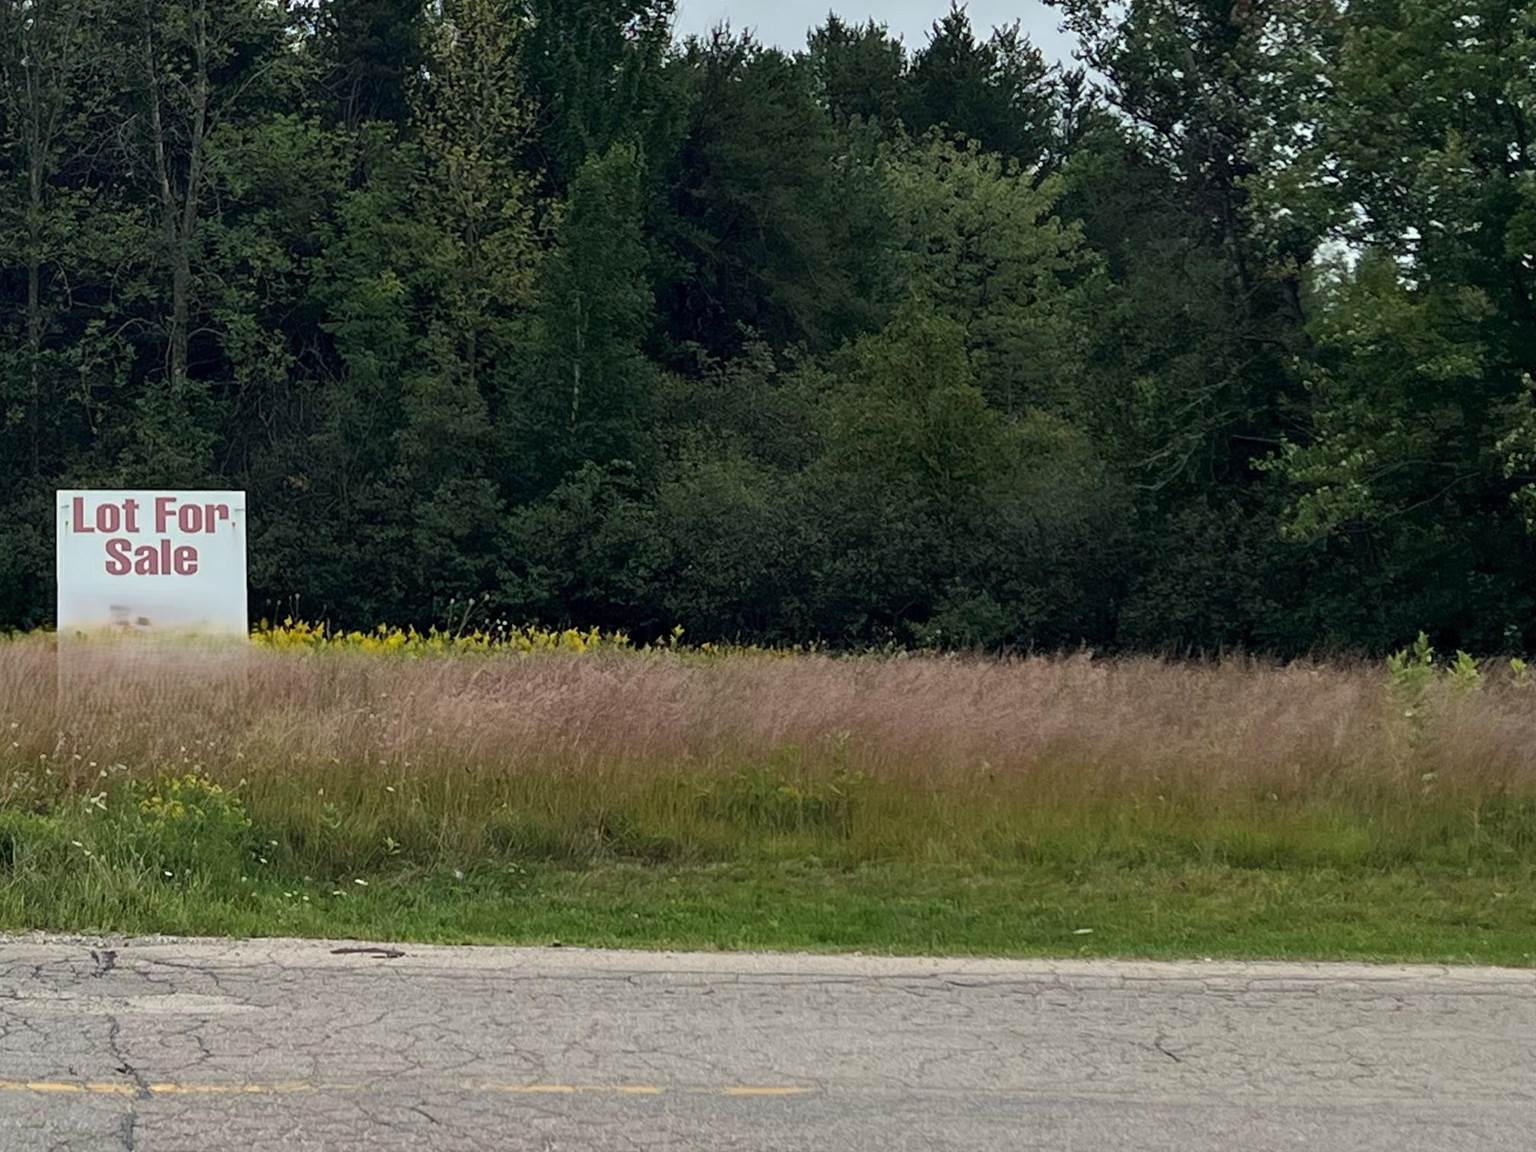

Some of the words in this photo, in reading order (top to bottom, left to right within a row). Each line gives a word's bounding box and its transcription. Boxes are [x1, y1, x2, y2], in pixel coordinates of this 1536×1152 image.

[72, 497, 140, 534] Lot
[154, 497, 230, 534] For
[105, 538, 199, 576] Sale
